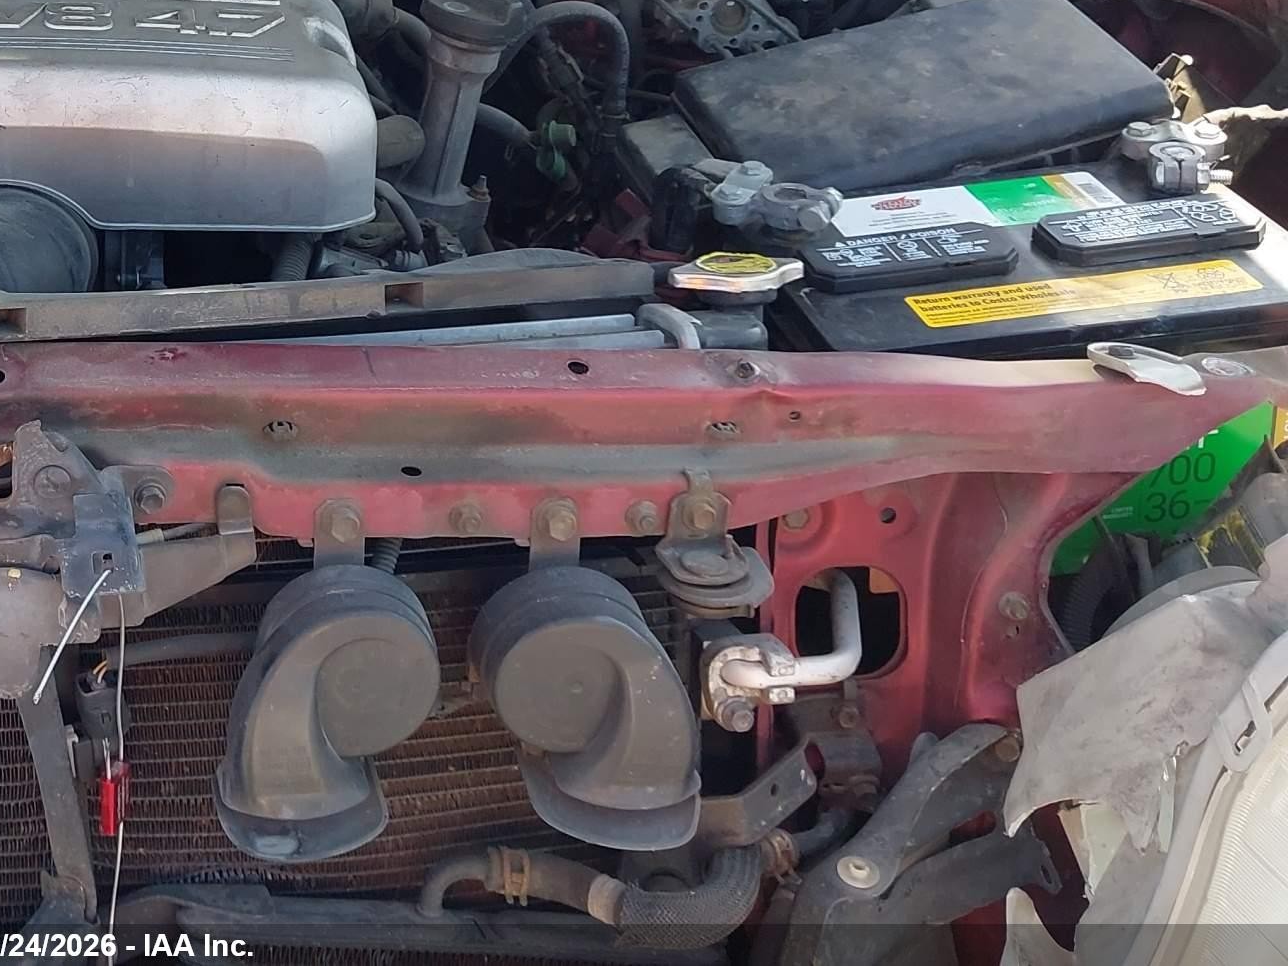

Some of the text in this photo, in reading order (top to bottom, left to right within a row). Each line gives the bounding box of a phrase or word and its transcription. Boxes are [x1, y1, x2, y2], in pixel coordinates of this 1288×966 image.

[135, 7, 286, 38] 4.7
[846, 235, 898, 246] DANGER
[908, 227, 957, 238] POISON
[913, 283, 1052, 305] Return warranty and used
[918, 302, 969, 312] batteries
[982, 295, 1017, 305] Costco
